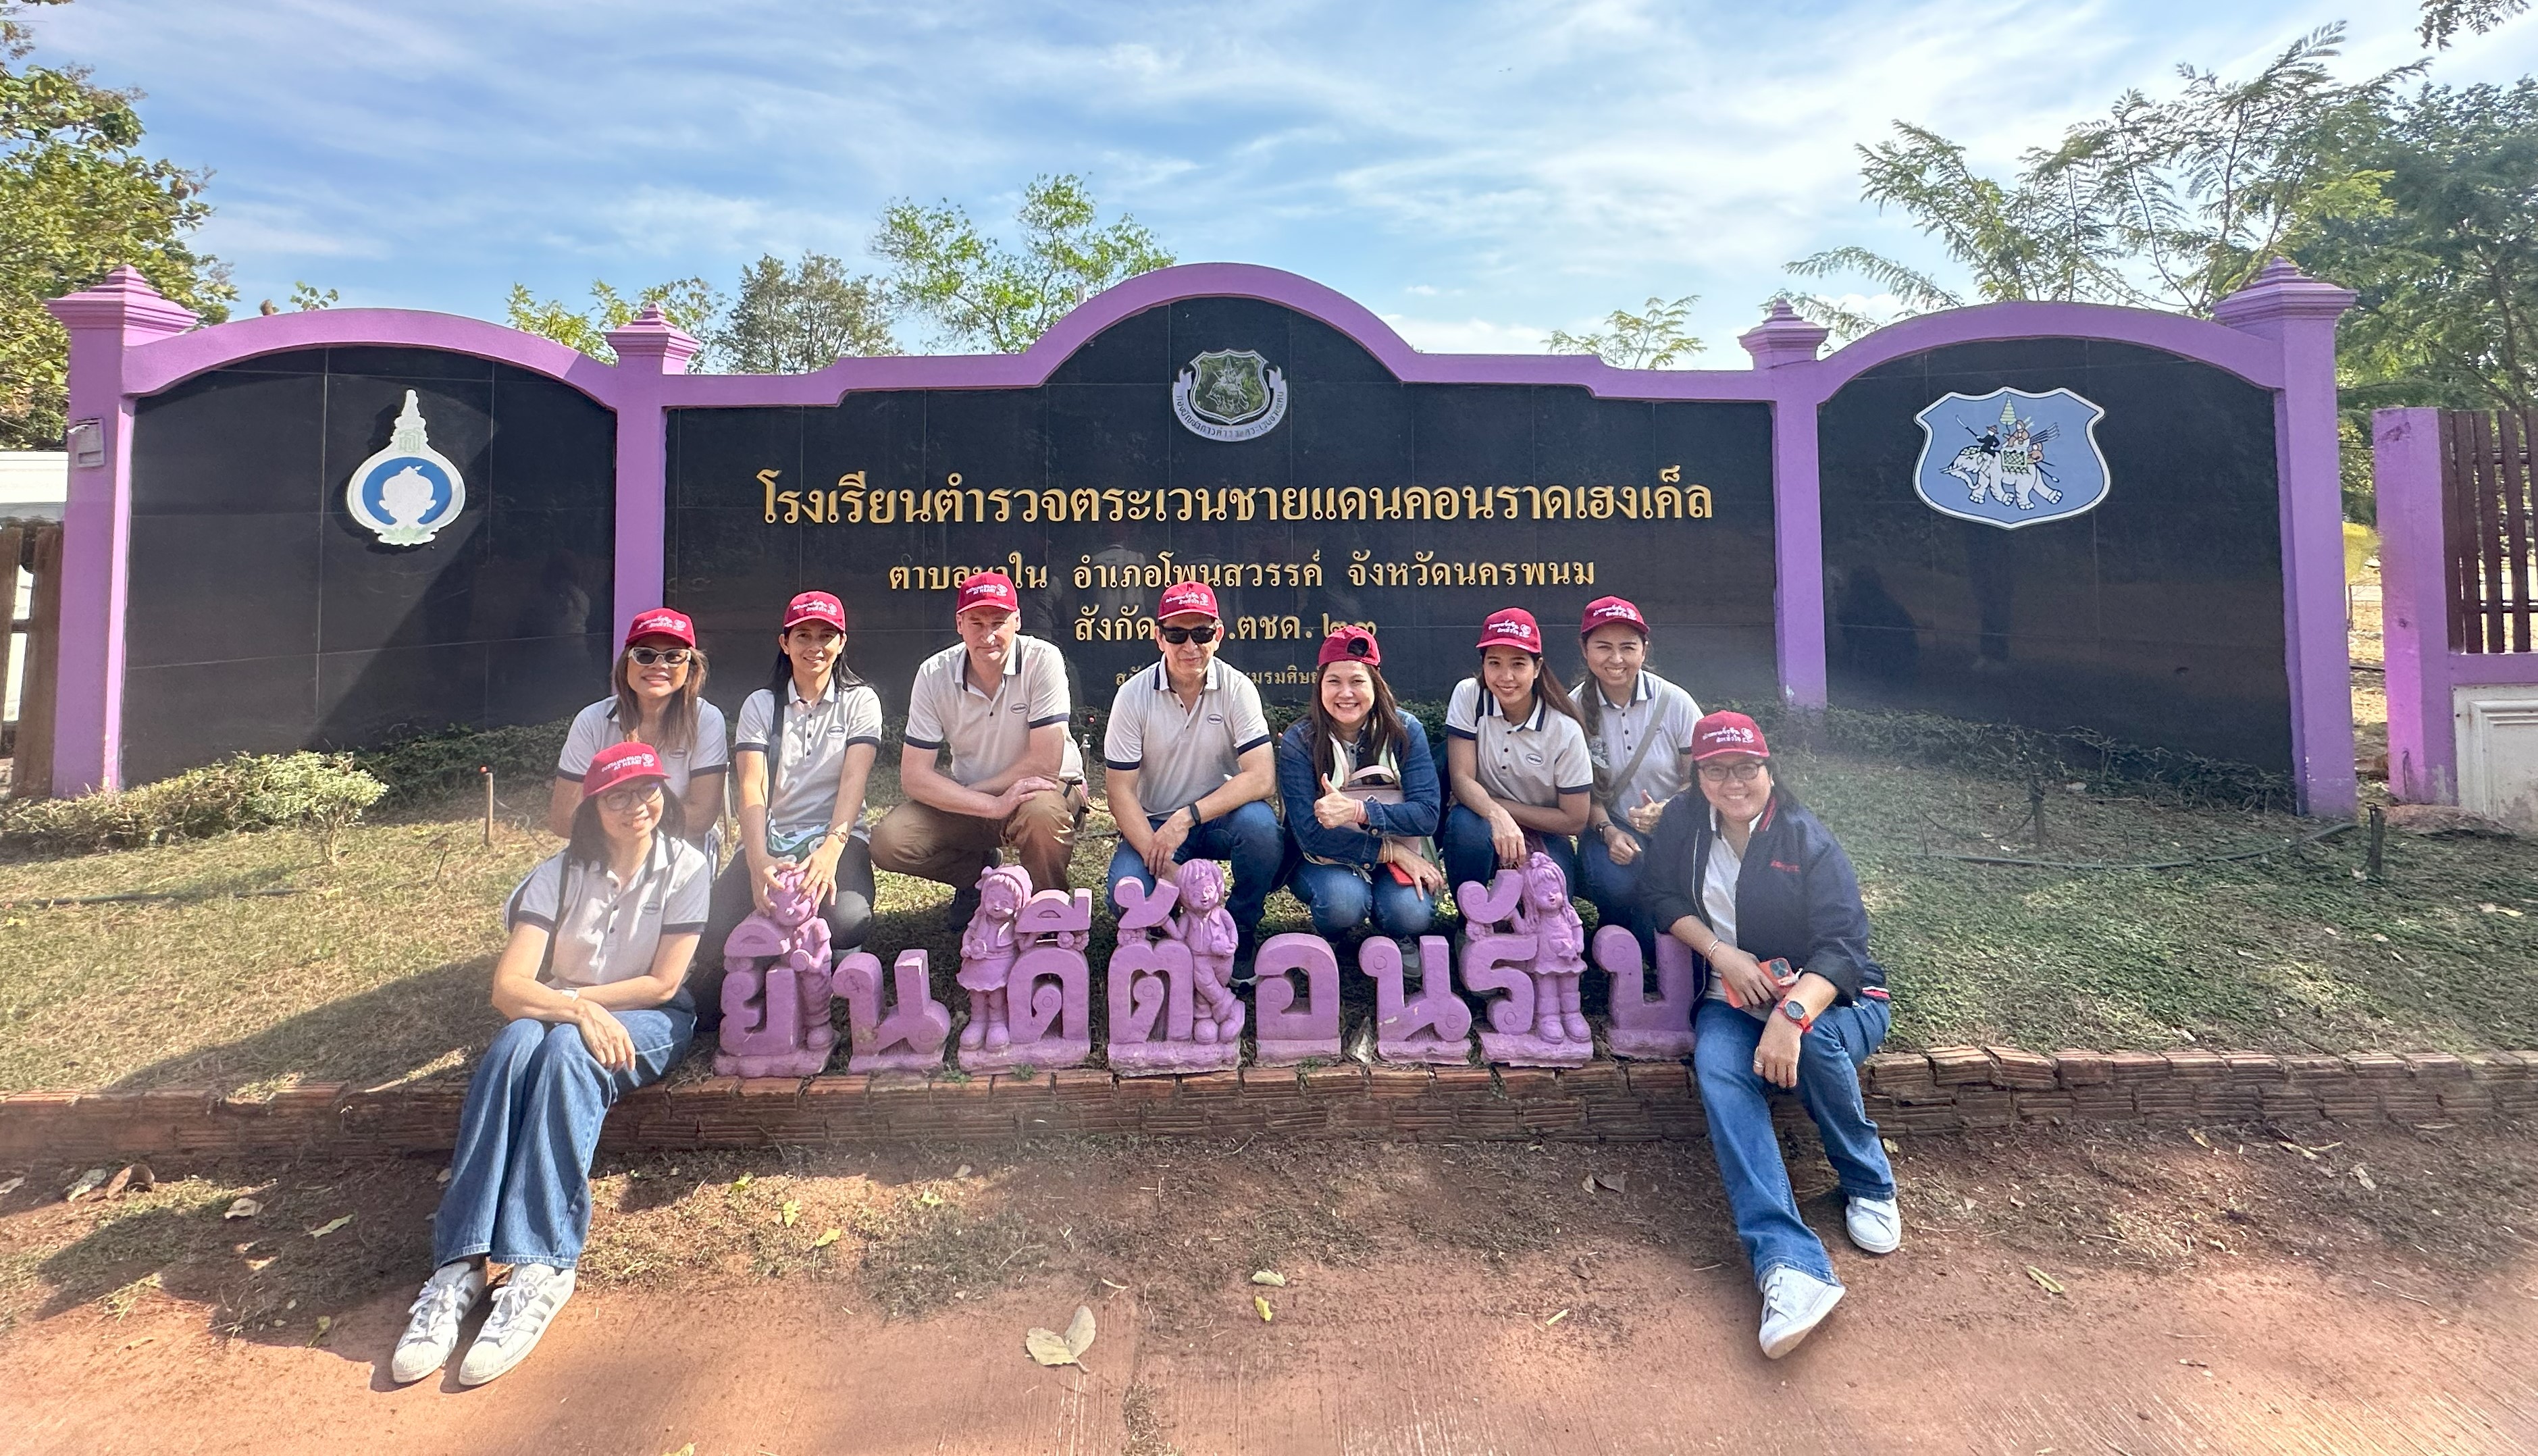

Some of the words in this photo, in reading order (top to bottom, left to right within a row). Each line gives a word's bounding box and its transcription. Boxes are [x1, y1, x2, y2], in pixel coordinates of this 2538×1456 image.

[756, 465, 1713, 524] โรงเรียนตำรวจตระเวนชายแดนคอนราดเฮงเค็ล
[1073, 550, 1323, 589] อำเภอโพนสวรรค์
[1347, 549, 1596, 587] จังหวัดนครพนม
[1074, 603, 1156, 641] สังกัด
